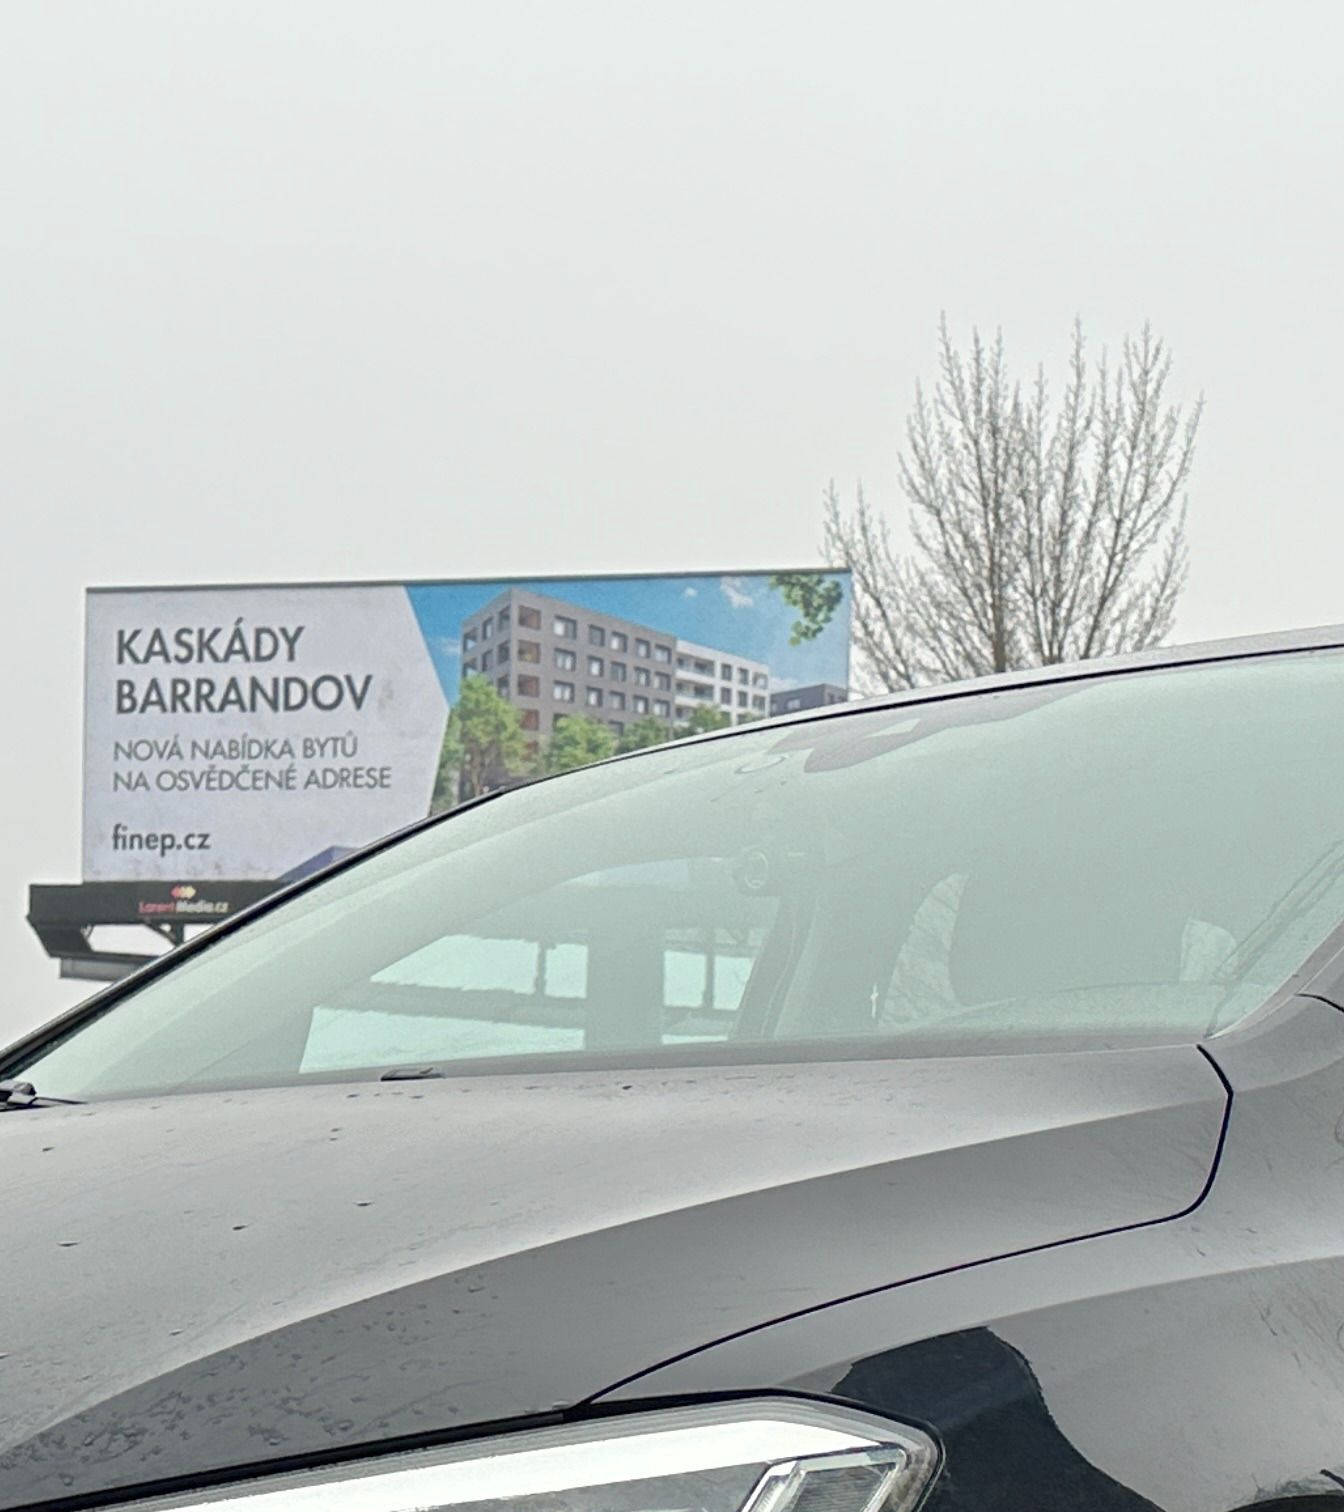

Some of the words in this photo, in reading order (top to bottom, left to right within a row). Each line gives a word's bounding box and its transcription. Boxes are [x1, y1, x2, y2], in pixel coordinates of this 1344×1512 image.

[116, 617, 305, 664] KASKÁDY
[116, 674, 373, 714] BARRANDOV
[113, 734, 184, 761] NOVÁ
[191, 733, 296, 760] NABÍDKA
[303, 730, 358, 759] BYTŮ
[113, 771, 150, 792] NA
[156, 764, 297, 791] OSVĚDČENÉ
[304, 767, 392, 789] ADRESE
[112, 823, 210, 857] finep.cz
